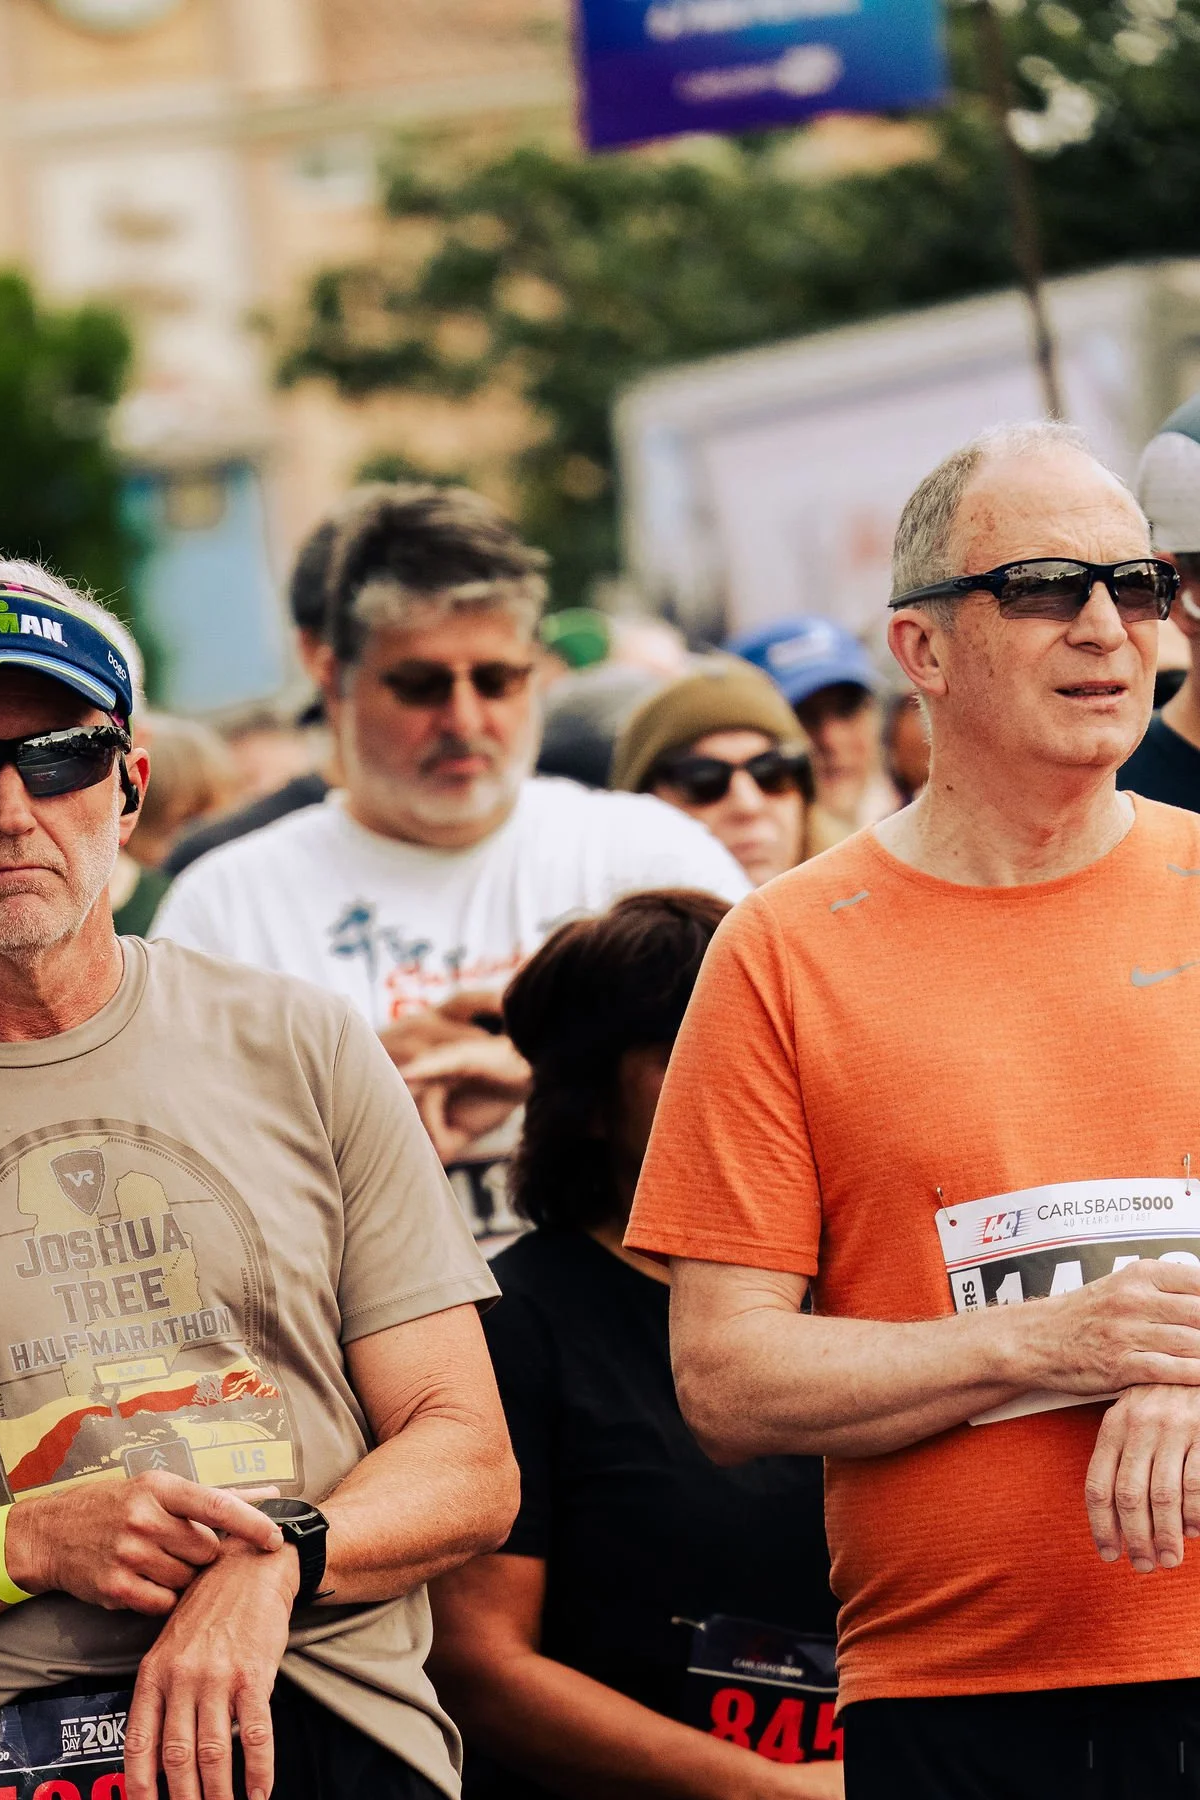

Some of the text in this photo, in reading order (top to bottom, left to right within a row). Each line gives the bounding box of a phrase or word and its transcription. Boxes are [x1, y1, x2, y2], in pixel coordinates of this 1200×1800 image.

[1037, 1196, 1174, 1221] CARLSBAD5000
[15, 1211, 191, 1280] JOSHUA
[52, 1267, 171, 1326] TREE
[8, 1307, 231, 1374] HALF MARATHON
[62, 1724, 81, 1739] ALL
[62, 1738, 81, 1752] DAY
[80, 1717, 127, 1749] 20K
